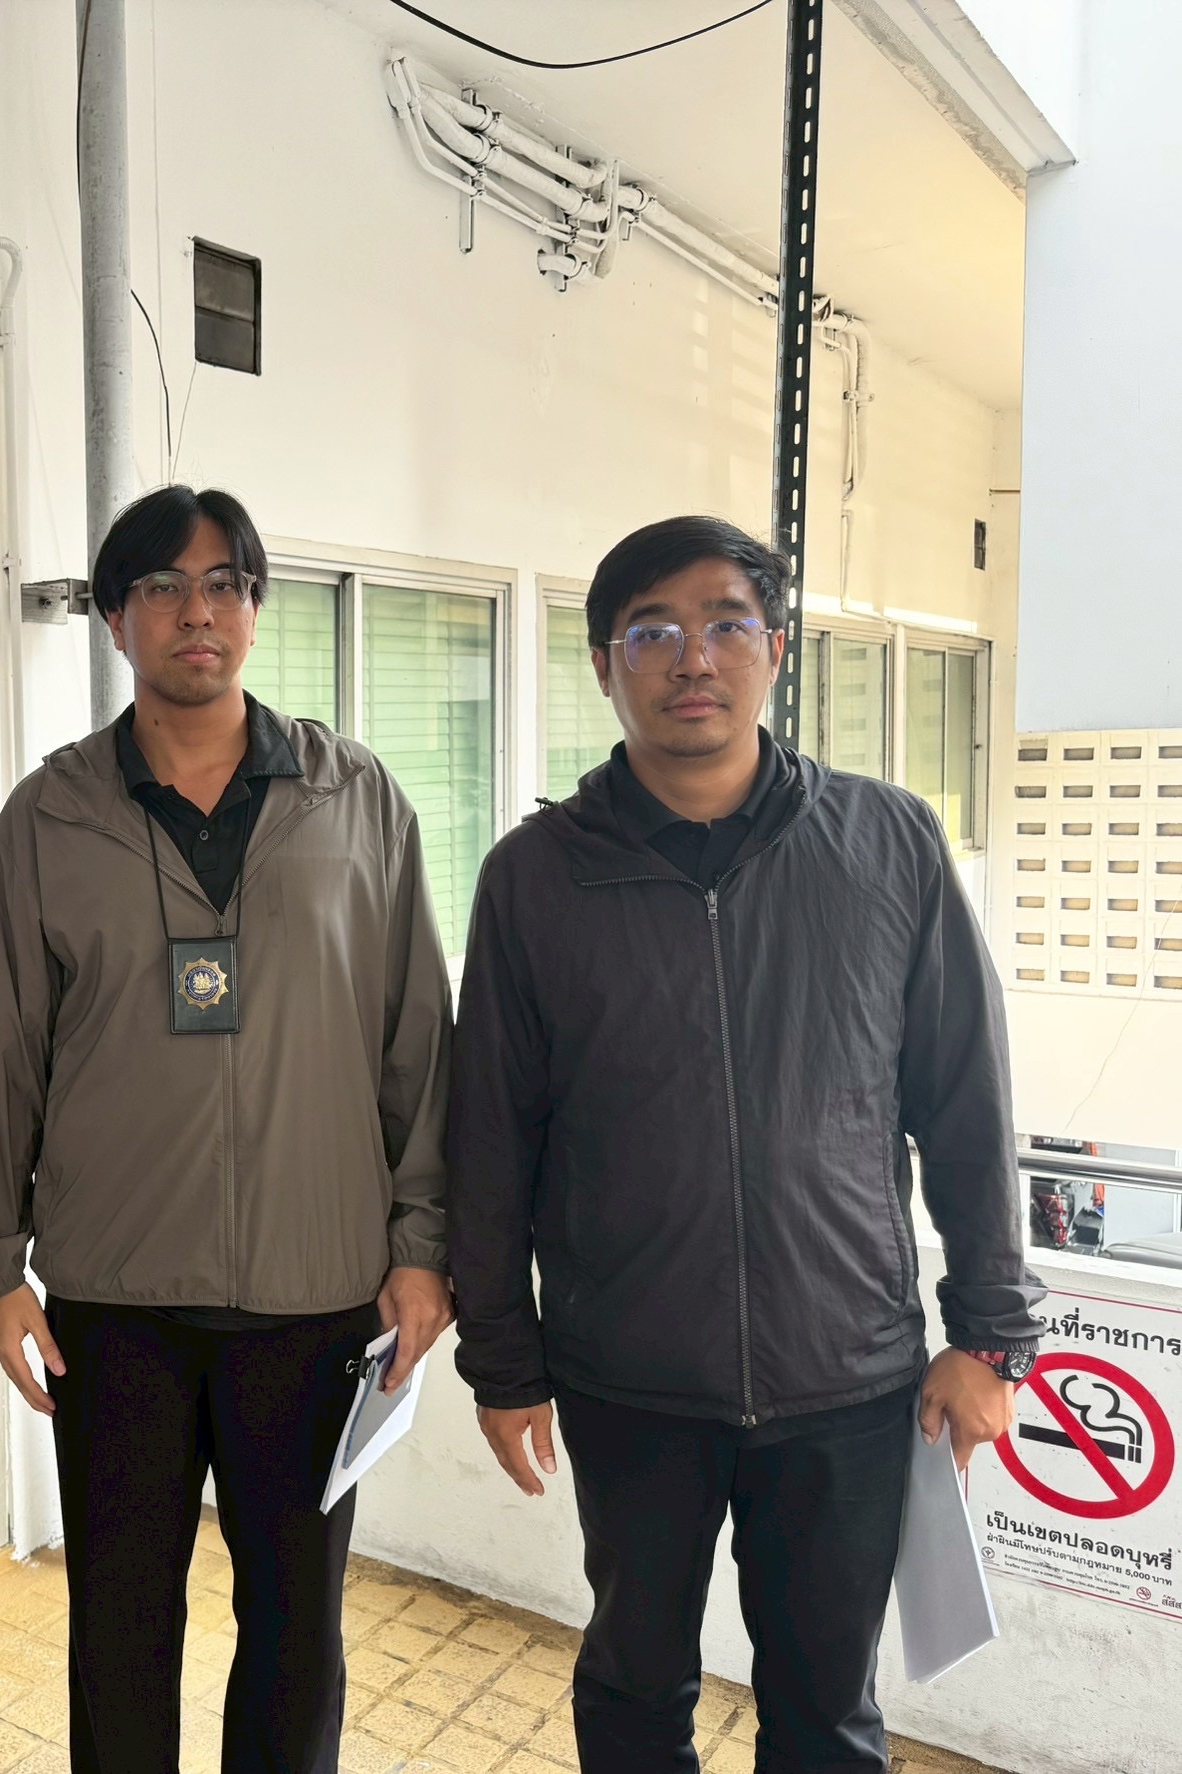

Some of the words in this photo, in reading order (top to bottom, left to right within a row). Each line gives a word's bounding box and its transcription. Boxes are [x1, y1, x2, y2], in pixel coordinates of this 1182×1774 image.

[986, 1510, 1173, 1570] เป็นเขตปลอดบุหรี่
[987, 1533, 1122, 1575] ฝ่าฝืนมีโทษปรับตามกฎหมาย
[1125, 1566, 1151, 1581] 5,000
[1152, 1575, 1172, 1586] บาท
